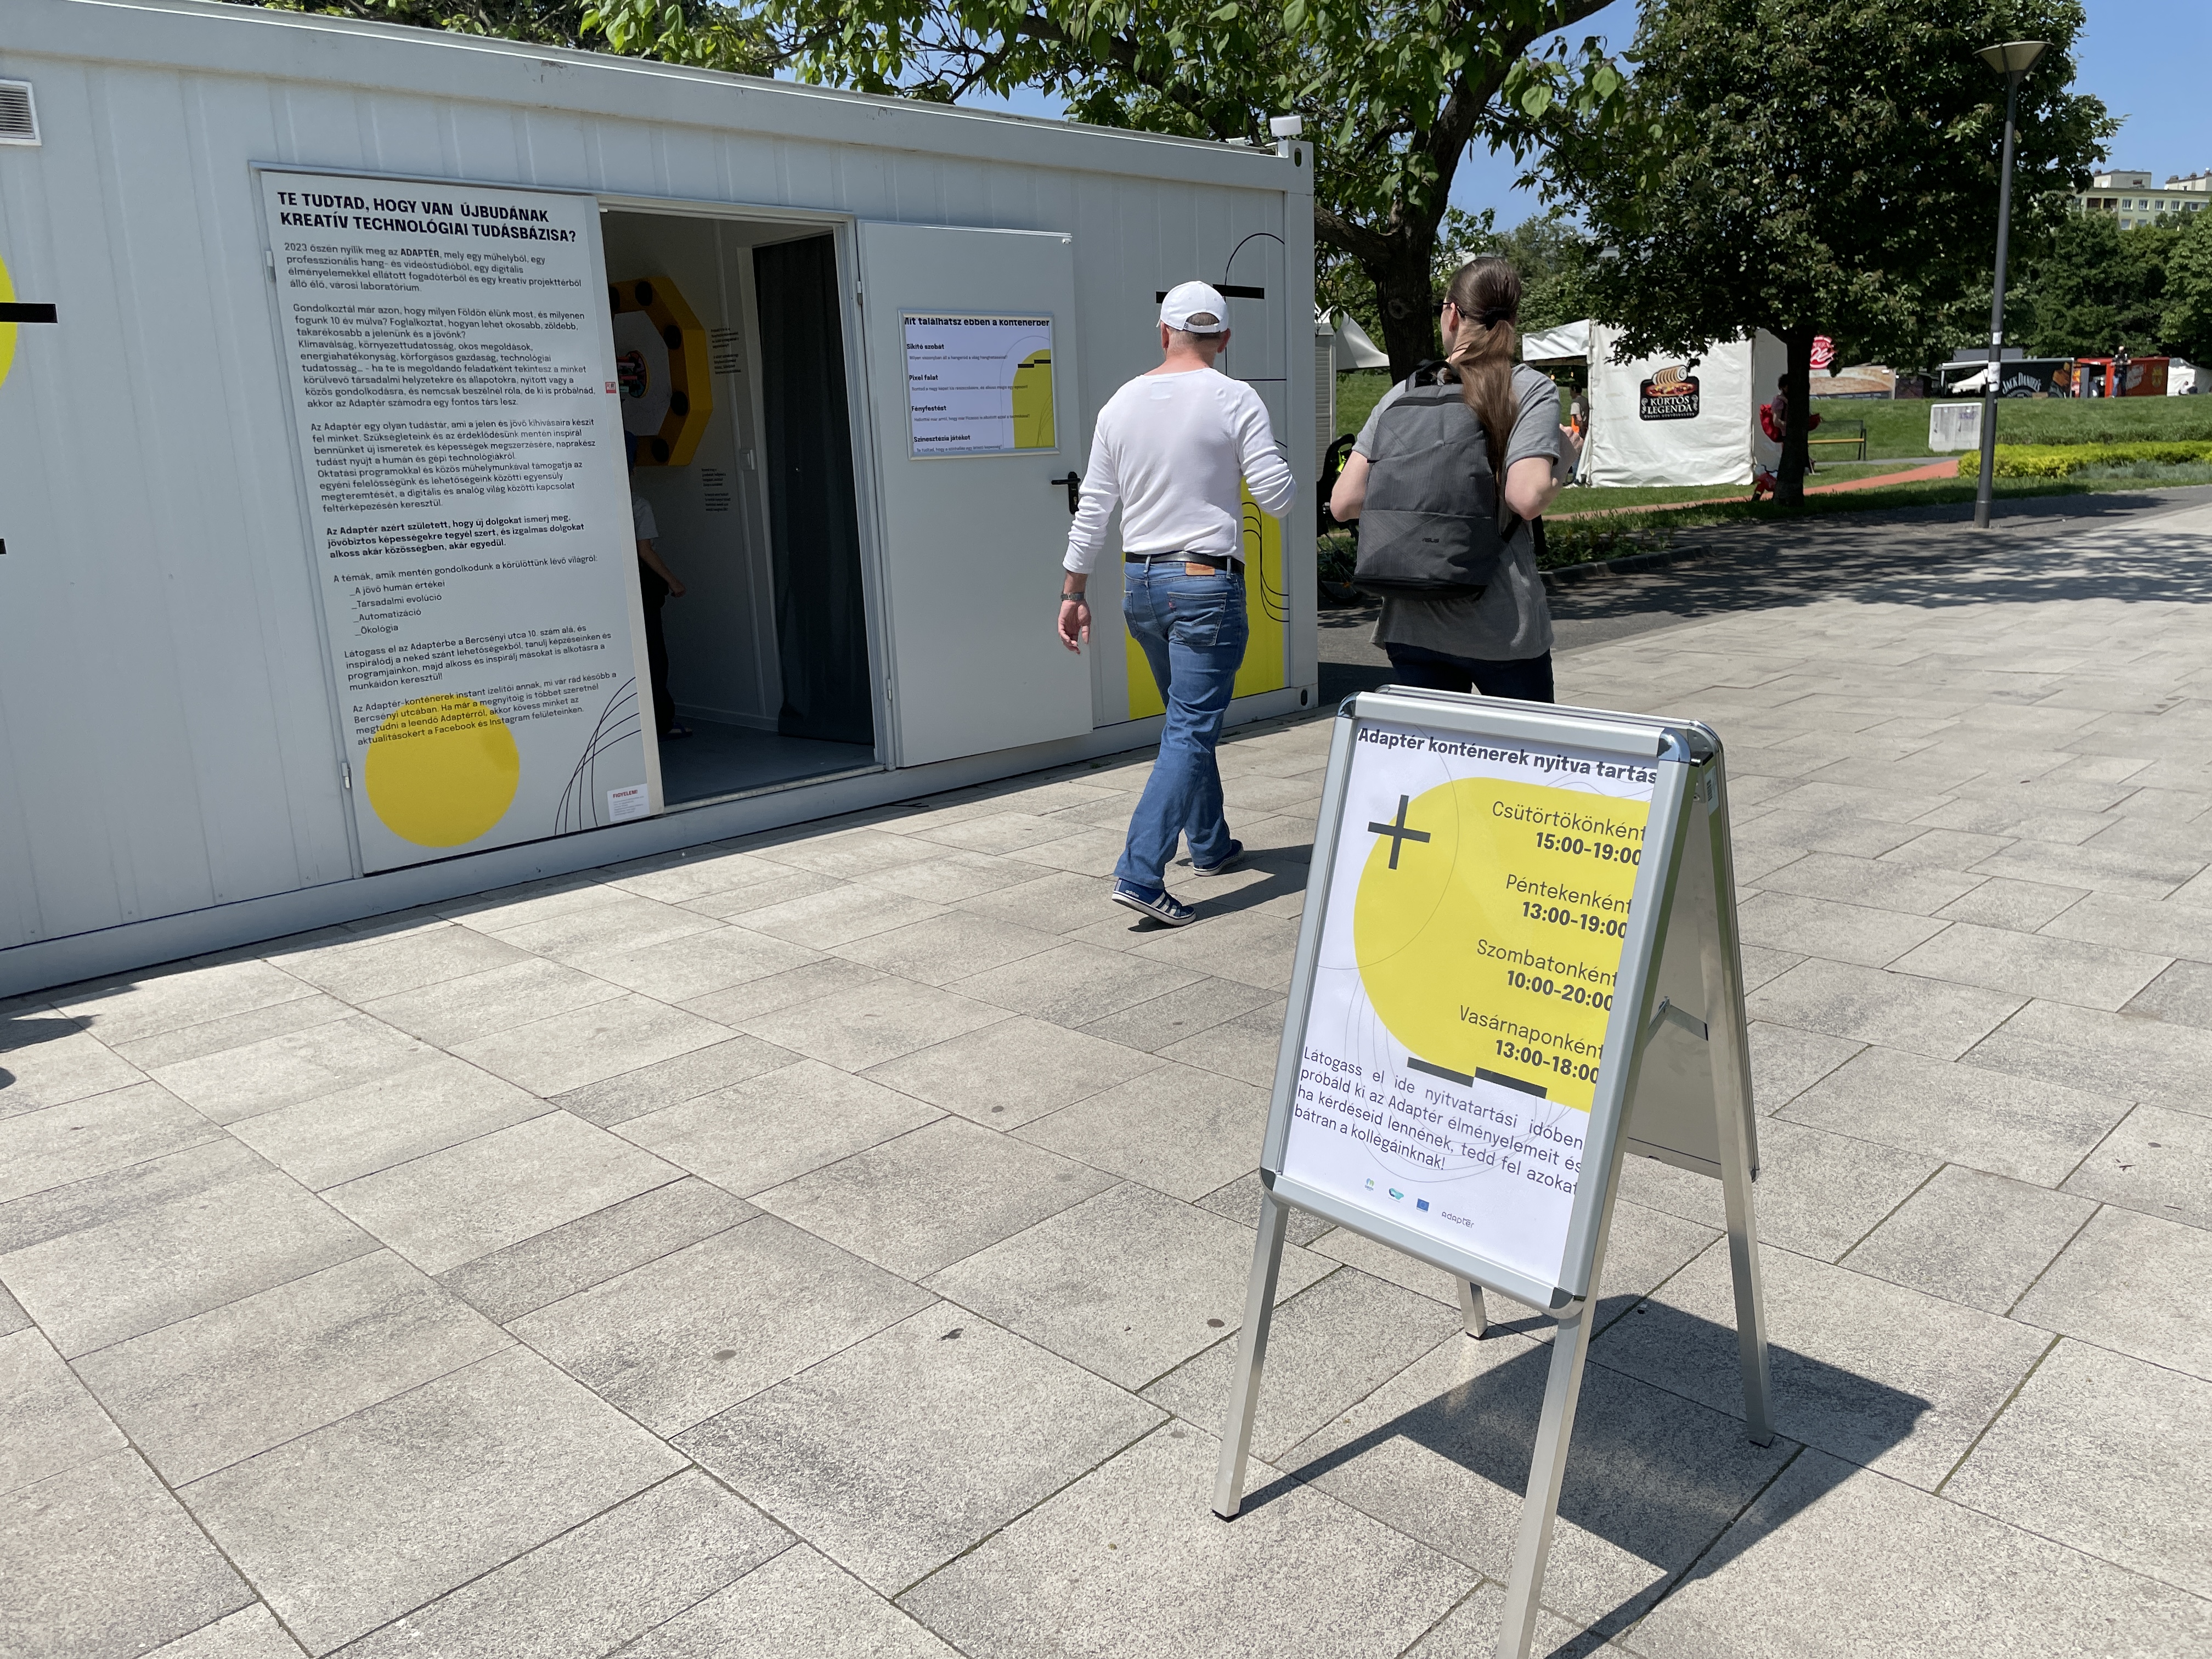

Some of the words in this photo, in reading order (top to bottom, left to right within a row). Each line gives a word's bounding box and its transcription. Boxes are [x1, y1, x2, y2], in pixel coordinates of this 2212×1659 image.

[277, 191, 298, 206] TE
[301, 193, 370, 213] TUDTAD,
[373, 198, 417, 214] HOGY
[421, 201, 453, 216] VAN
[460, 202, 549, 223] ÚJBUDÁNAK
[280, 211, 348, 229] KREATÍV
[352, 215, 469, 236] TECHNOLÓGIAI
[471, 223, 576, 242] TUDÁSBÁZISA?
[284, 242, 307, 252] 2023
[340, 245, 364, 256] nyílik
[365, 248, 386, 258] meg
[400, 248, 442, 259] ADAPTÉR,
[443, 251, 465, 262] mely
[466, 253, 482, 262] egy
[531, 257, 545, 266] egy
[360, 257, 388, 271] hang-
[391, 259, 402, 268] és
[473, 265, 489, 274] egy
[491, 264, 524, 276] digitális
[329, 281, 359, 290] városi
[373, 270, 407, 280] ellátott
[481, 276, 496, 285] egy
[498, 275, 527, 285] kreatív
[296, 327, 363, 337] takarékosabb
[372, 329, 411, 340] jelenünk
[413, 330, 424, 338] és
[458, 341, 479, 350] okos
[2002, 375, 2018, 395] JACK
[1647, 404, 1693, 415] LEGENDA
[326, 527, 338, 535] Az
[340, 525, 379, 536] Adaptér
[381, 523, 405, 532] azért
[452, 520, 474, 530] hogy
[475, 518, 484, 529] új
[485, 516, 522, 527] dolgokat
[523, 514, 550, 524] ismerj
[550, 515, 571, 524] meg,
[444, 529, 472, 542] tegyél
[473, 528, 499, 538] szert,
[500, 527, 511, 535] és
[512, 526, 548, 536] izgalmas
[549, 523, 584, 533] dolgokat
[329, 549, 360, 558] alkoss
[362, 547, 383, 556] akár
[449, 541, 468, 550] akár
[349, 678, 399, 691] munkáidon
[400, 672, 443, 685] keresztül!
[356, 721, 399, 735] megtudni
[489, 707, 511, 715] akkor
[542, 697, 568, 708] minket
[435, 721, 476, 734] Facebook
[489, 715, 531, 726] Instagram
[1358, 728, 1425, 750] Adaptér
[1427, 737, 1530, 765] konténerek
[1533, 753, 1591, 775] nyitva
[1596, 760, 1657, 784] tartás
[613, 789, 638, 799] FIGYELEM!
[1493, 801, 1645, 842] Csütörtökönként
[1536, 832, 1641, 866] 15:00-19:00
[1506, 873, 1632, 915] Péntekenként
[1523, 901, 1627, 939] 13:00-19:00
[1508, 970, 1612, 1012] 10:00-20:00
[1496, 1040, 1598, 1084] 13:00-18:00
[1304, 1046, 1362, 1076] Látogass
[1373, 1070, 1385, 1084] el
[1395, 1075, 1415, 1093] ide
[1425, 1089, 1518, 1128] nyitvatartási
[1529, 1119, 1583, 1150] időben
[1297, 1084, 1313, 1102] ha
[1318, 1091, 1384, 1126] kérdéseid
[1388, 1115, 1453, 1152] lennének,
[1462, 1142, 1496, 1166] tedd
[1502, 1156, 1521, 1175] fel
[1300, 1069, 1351, 1093] próbáld
[1355, 1082, 1365, 1098] ki
[1369, 1092, 1384, 1105] az
[1388, 1095, 1443, 1124] Adaptér
[1448, 1116, 1560, 1165] élményelemeit
[1565, 1156, 1581, 1175] és
[1295, 1103, 1336, 1131] bátran
[1340, 1124, 1347, 1135] a
[1351, 1123, 1445, 1171] kollégáinknak!
